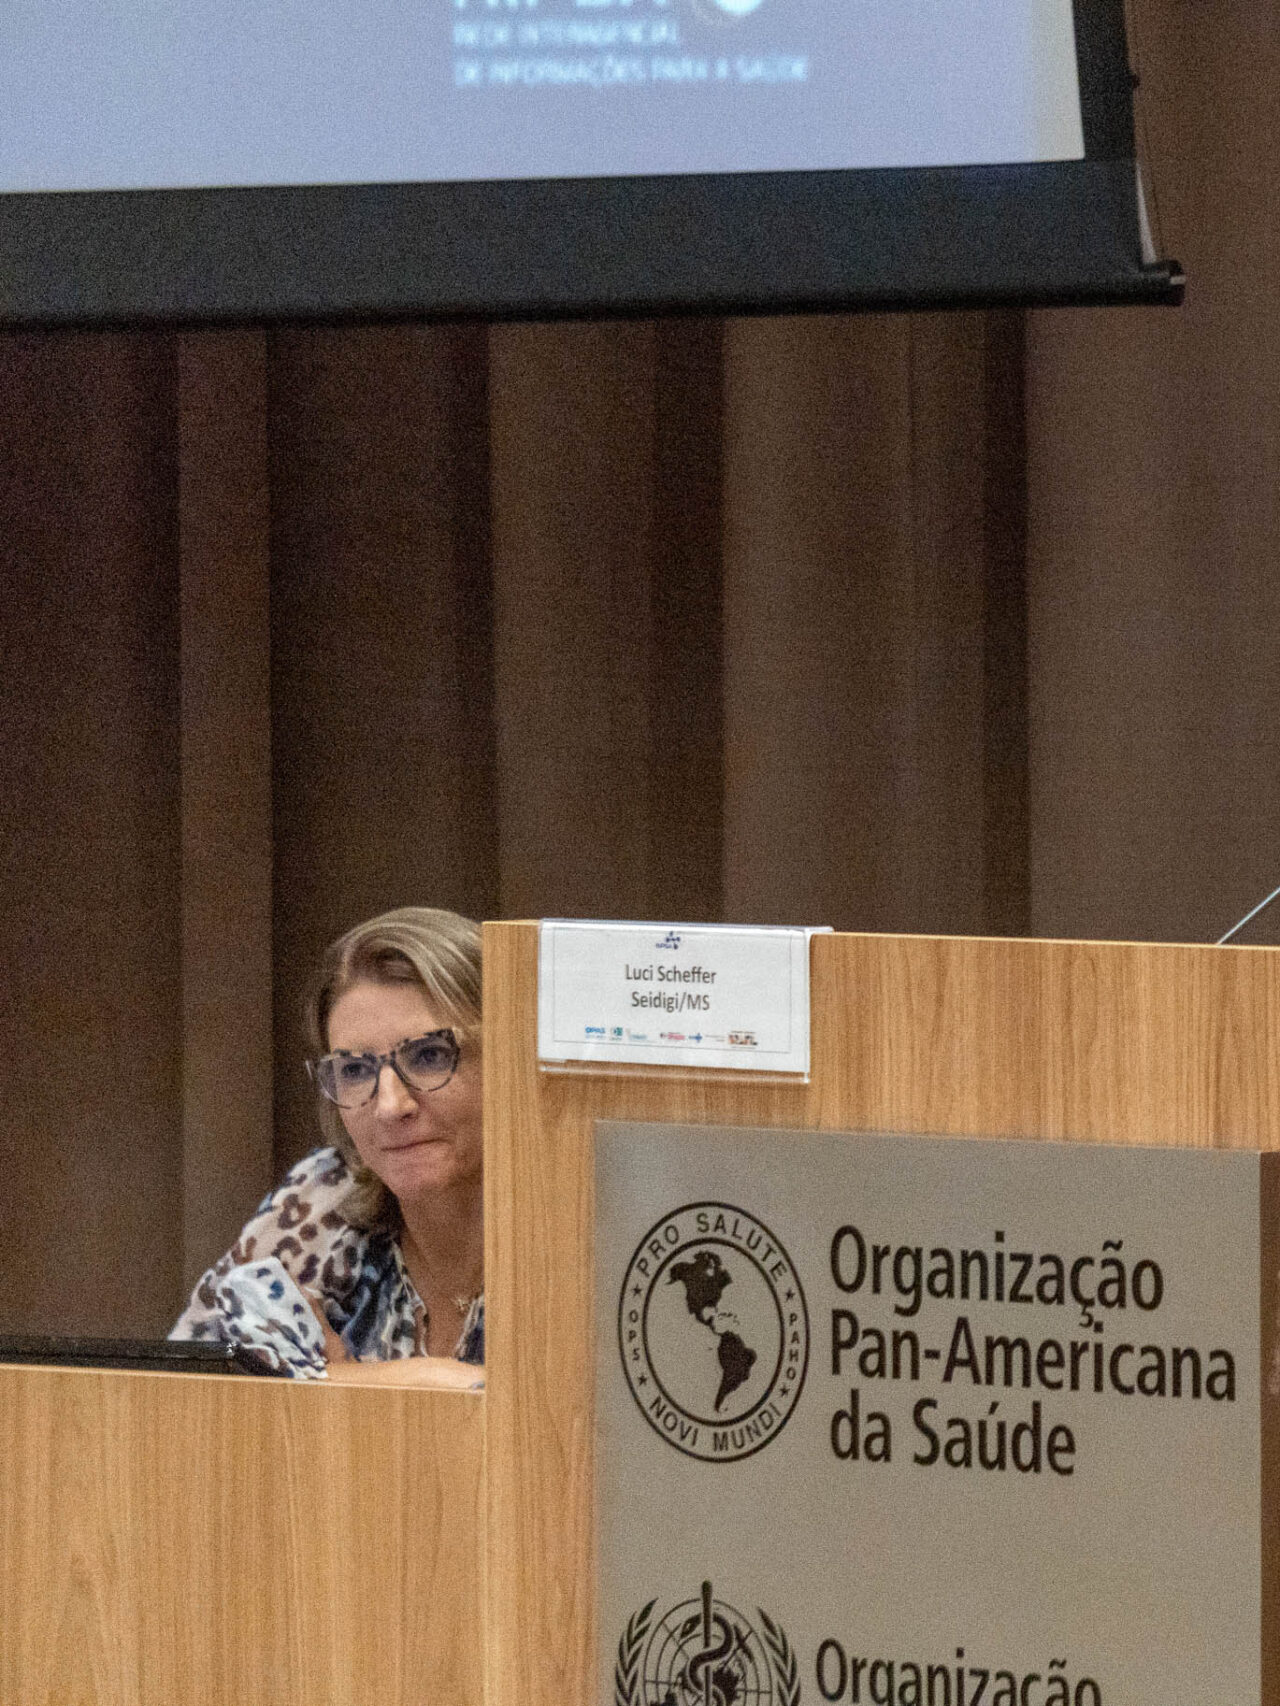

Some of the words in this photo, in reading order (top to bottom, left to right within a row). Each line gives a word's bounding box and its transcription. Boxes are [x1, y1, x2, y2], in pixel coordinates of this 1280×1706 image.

[625, 964, 654, 981] Luci
[657, 965, 717, 984] Scheffer
[632, 991, 710, 1013] Seidigi/MS
[636, 1225, 680, 1278] PRO
[696, 1212, 788, 1283] SALUTE
[830, 1224, 1164, 1328] Organização
[628, 1309, 641, 1361] OPS
[785, 1312, 801, 1381] PAHO
[831, 1308, 1237, 1402] Pan-Americana
[649, 1396, 700, 1447] NOVI
[713, 1402, 782, 1452] MUNDI
[830, 1388, 892, 1463] da
[912, 1397, 1077, 1476] Saúde
